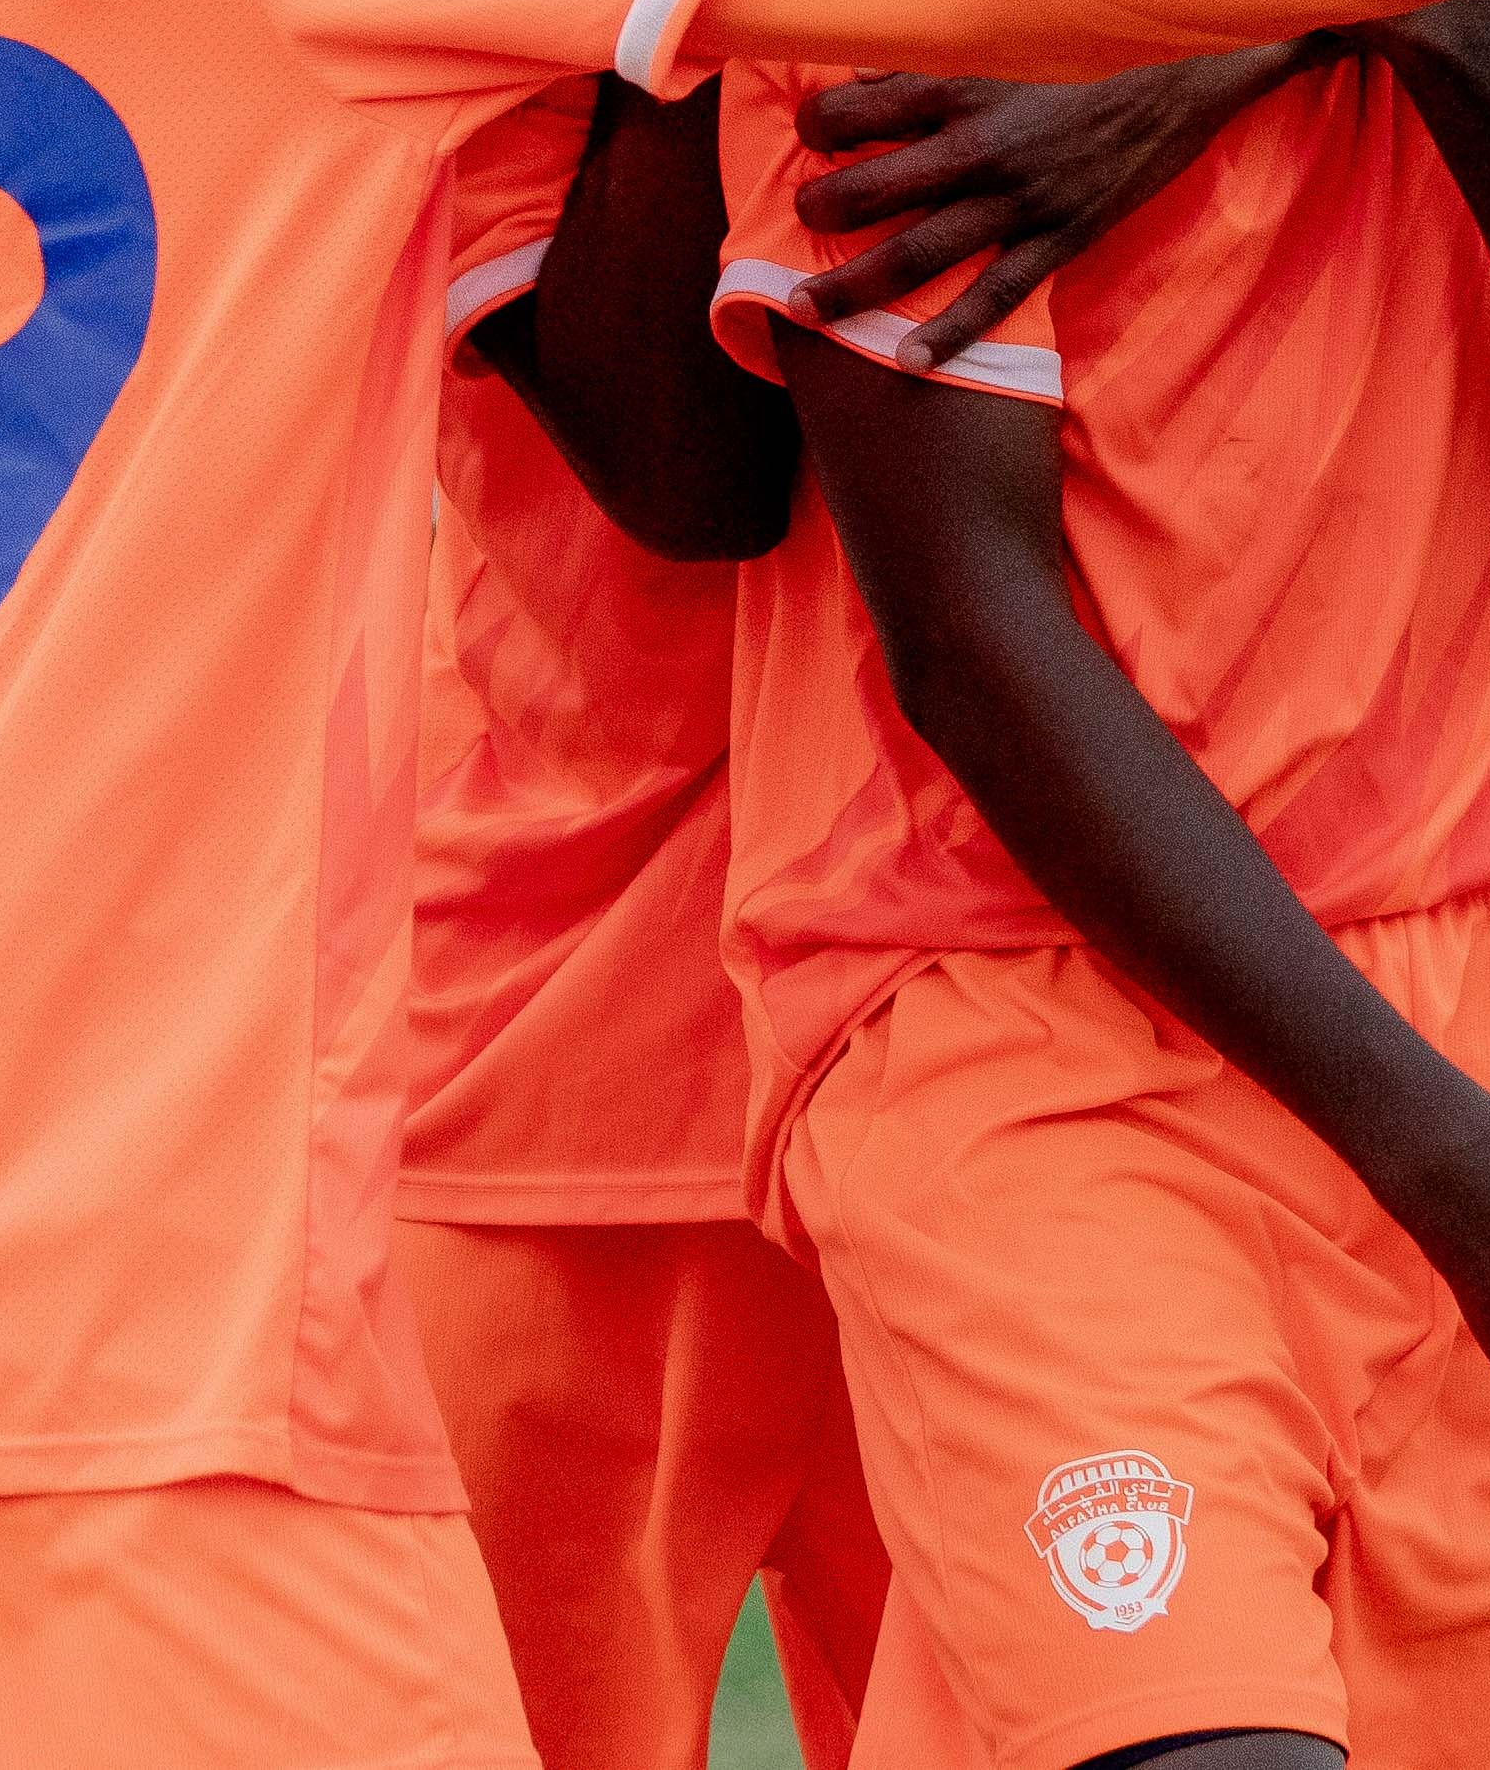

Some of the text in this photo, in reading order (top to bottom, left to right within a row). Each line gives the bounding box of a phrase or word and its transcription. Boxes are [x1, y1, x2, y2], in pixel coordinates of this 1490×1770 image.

[1049, 1501, 1170, 1541] ALFAYHA CLUB
[1113, 1601, 1144, 1618] 1953
